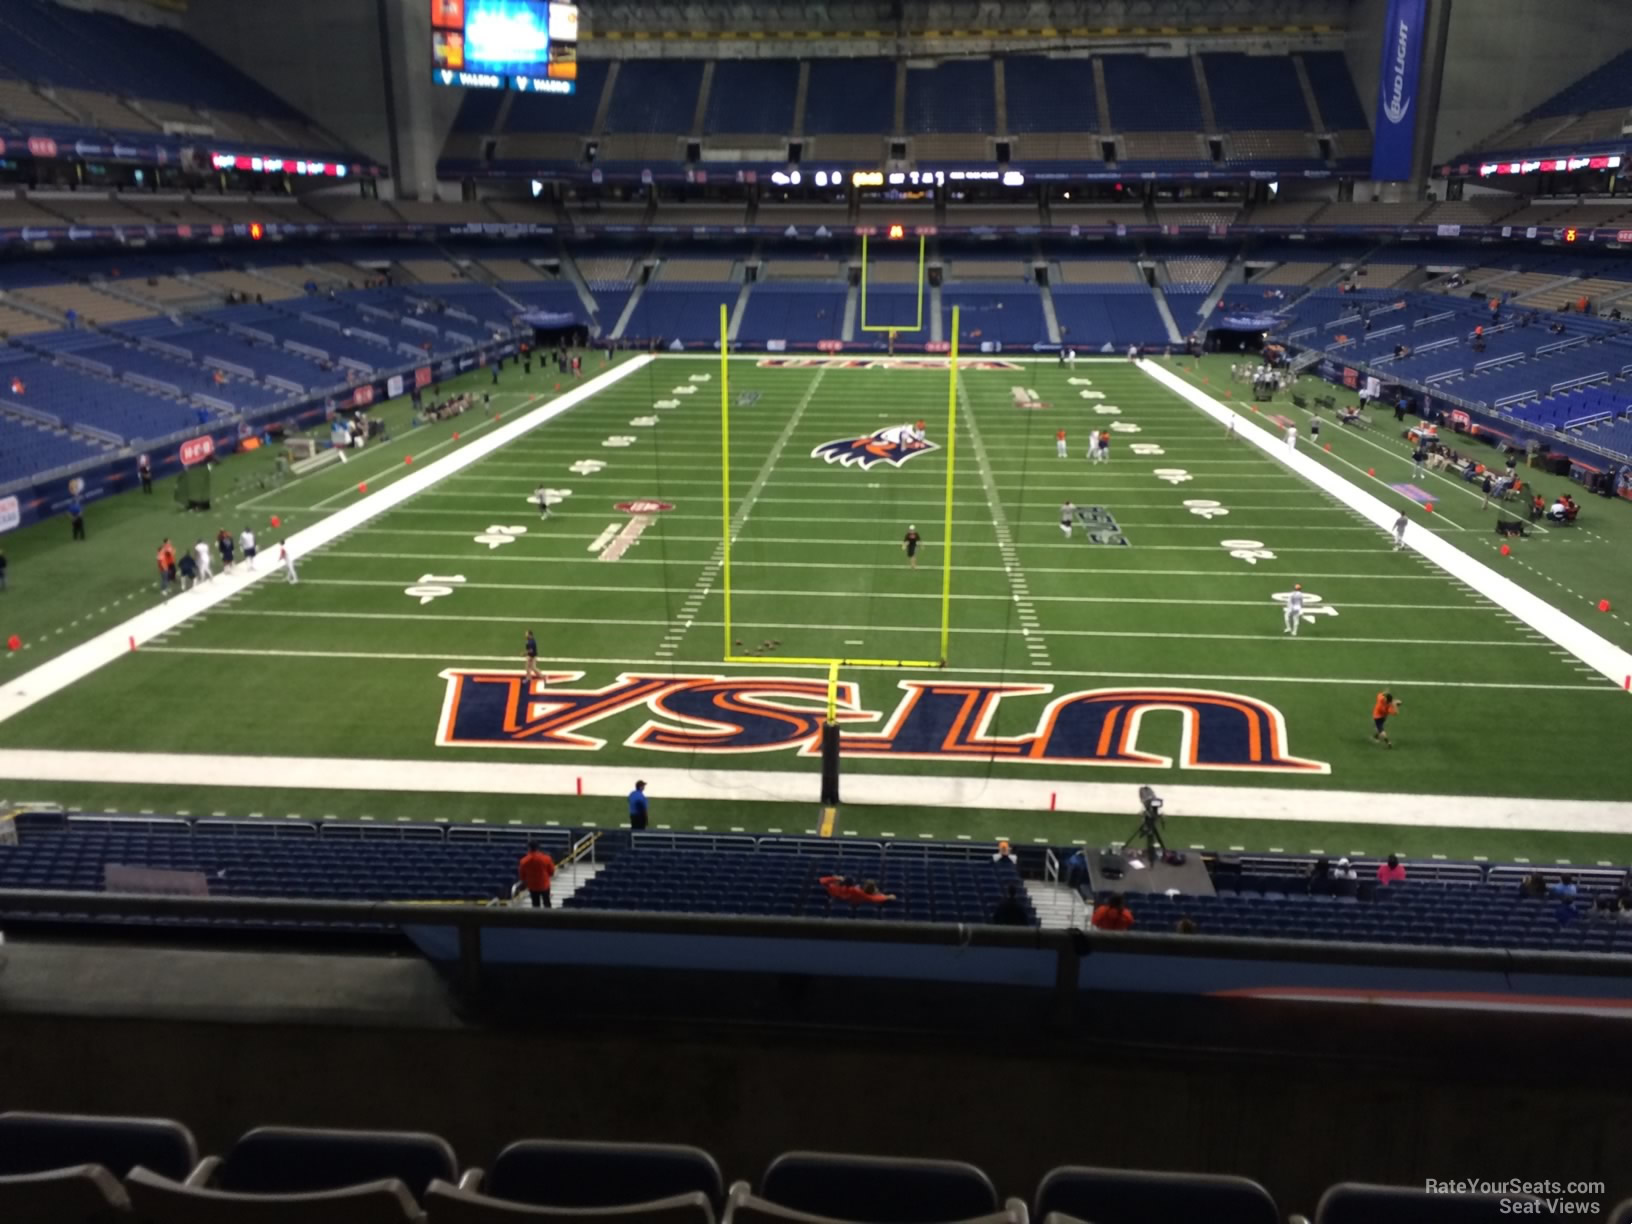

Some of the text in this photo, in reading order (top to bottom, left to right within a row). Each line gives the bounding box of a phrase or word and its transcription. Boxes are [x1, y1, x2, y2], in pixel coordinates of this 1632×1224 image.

[1390, 19, 1408, 117] BUD LIGHT
[434, 667, 1332, 775] UTSA
